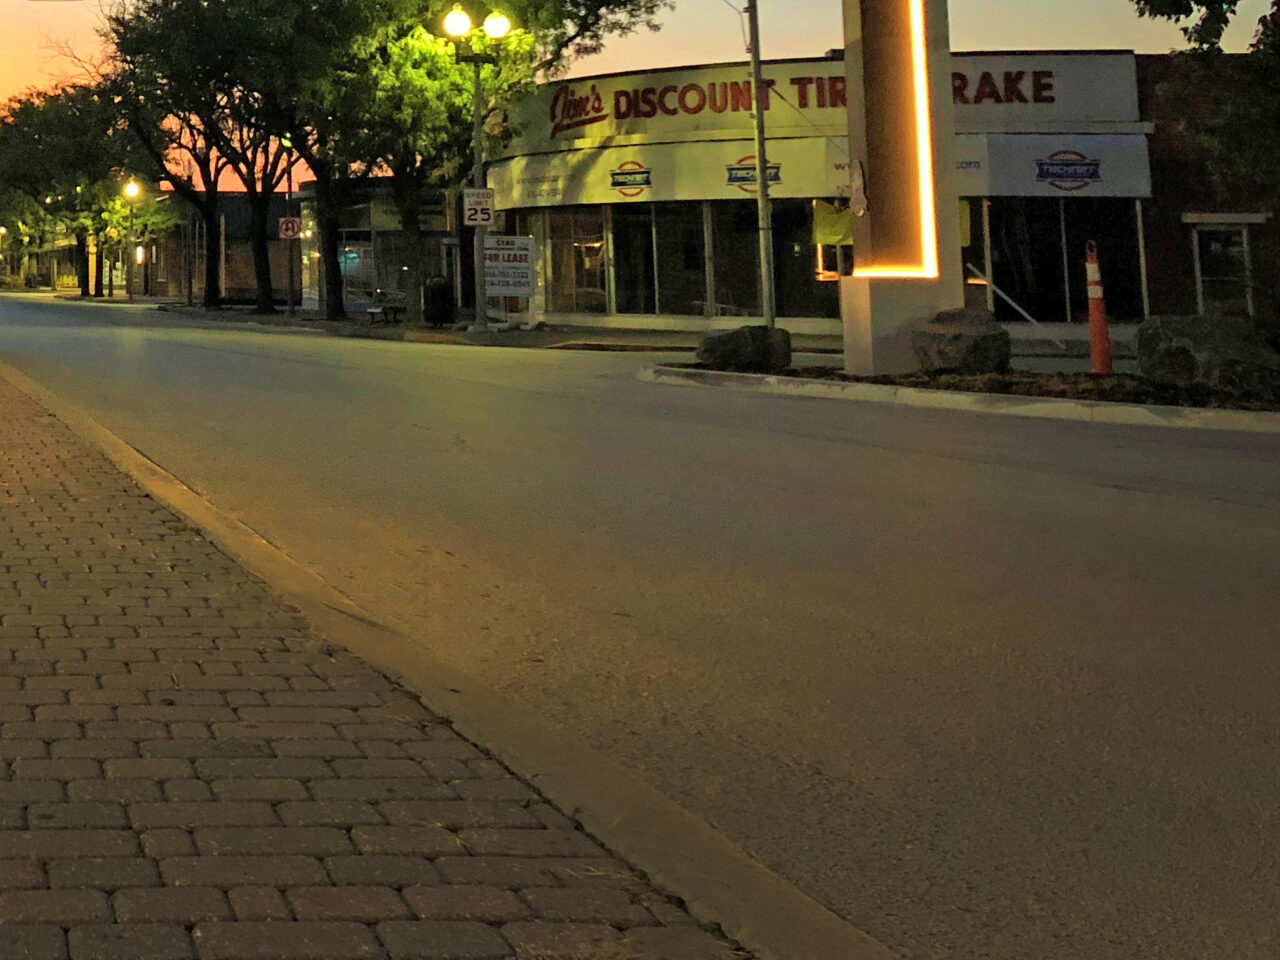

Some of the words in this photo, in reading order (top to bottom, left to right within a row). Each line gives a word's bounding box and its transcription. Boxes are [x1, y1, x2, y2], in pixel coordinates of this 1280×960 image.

[613, 79, 776, 120] DISCOUNT
[790, 76, 847, 109] TIR
[951, 70, 1056, 105] RAKE
[467, 208, 491, 221] 25
[503, 253, 529, 263] LEASE
